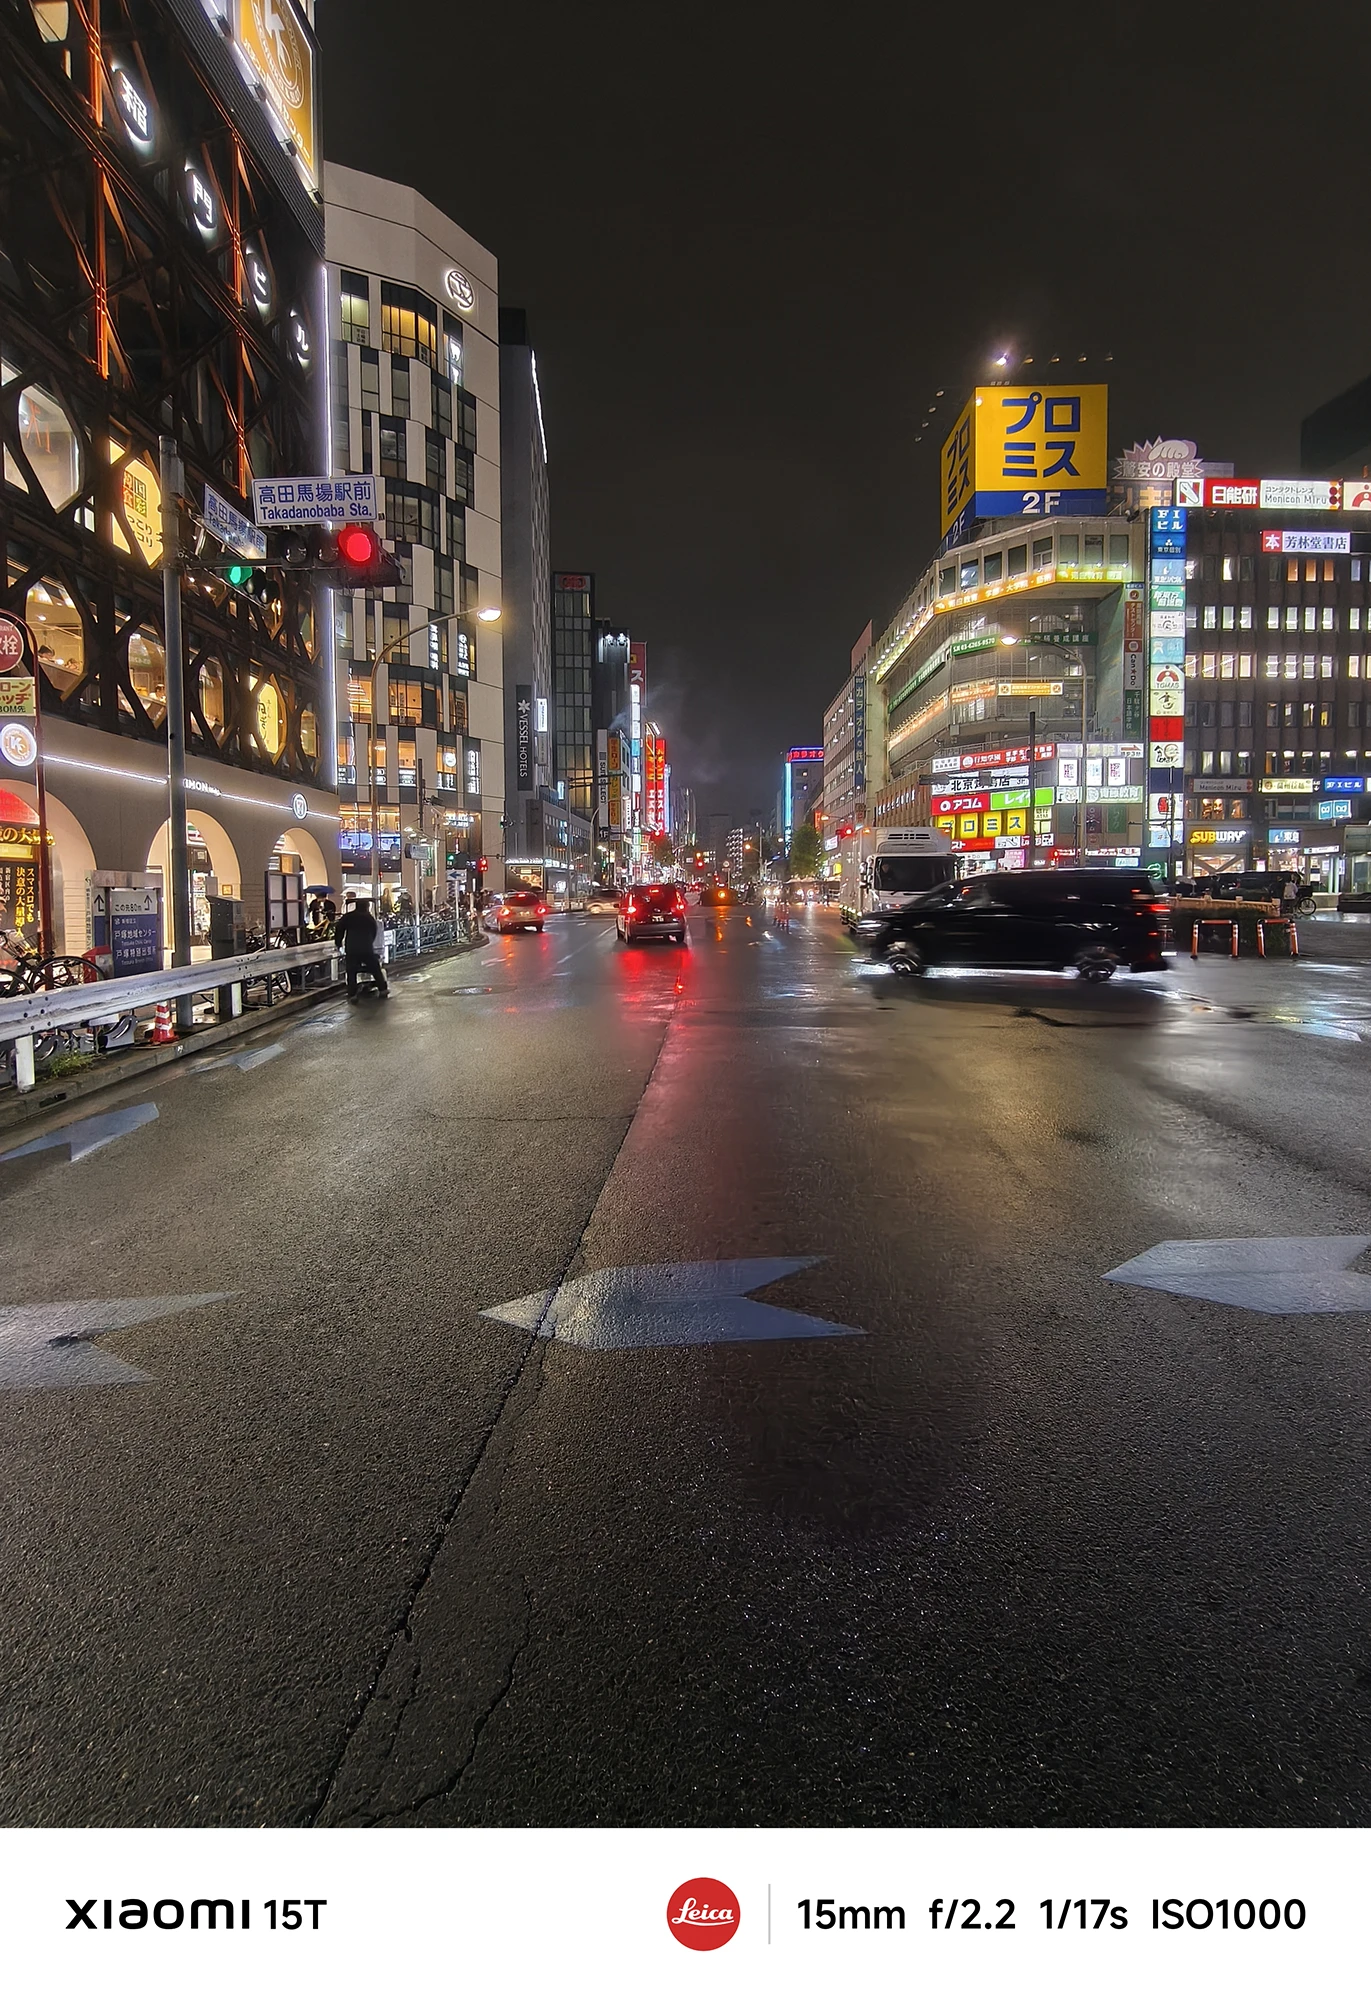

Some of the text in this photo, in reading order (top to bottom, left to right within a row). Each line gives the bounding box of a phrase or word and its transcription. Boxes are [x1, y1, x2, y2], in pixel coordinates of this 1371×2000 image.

[1002, 391, 1081, 434] プロ
[1002, 441, 1081, 478] ミス
[259, 481, 371, 505] 高田馬場駅前
[1212, 486, 1258, 505] 日能研
[1265, 486, 1315, 494] コンタクトレンズ
[1022, 492, 1061, 514] 2F
[1265, 494, 1328, 505] Menicon Miru
[260, 502, 372, 519] Takadanobaba Sta.
[1265, 534, 1281, 550] 本
[1285, 536, 1347, 550] 芳林堂書店
[0, 634, 19, 656] 栓
[0, 705, 27, 714] 0M先
[519, 713, 529, 778] VESSEL HOTELS
[953, 798, 982, 811] アコム
[1189, 830, 1247, 845] SUBWAY
